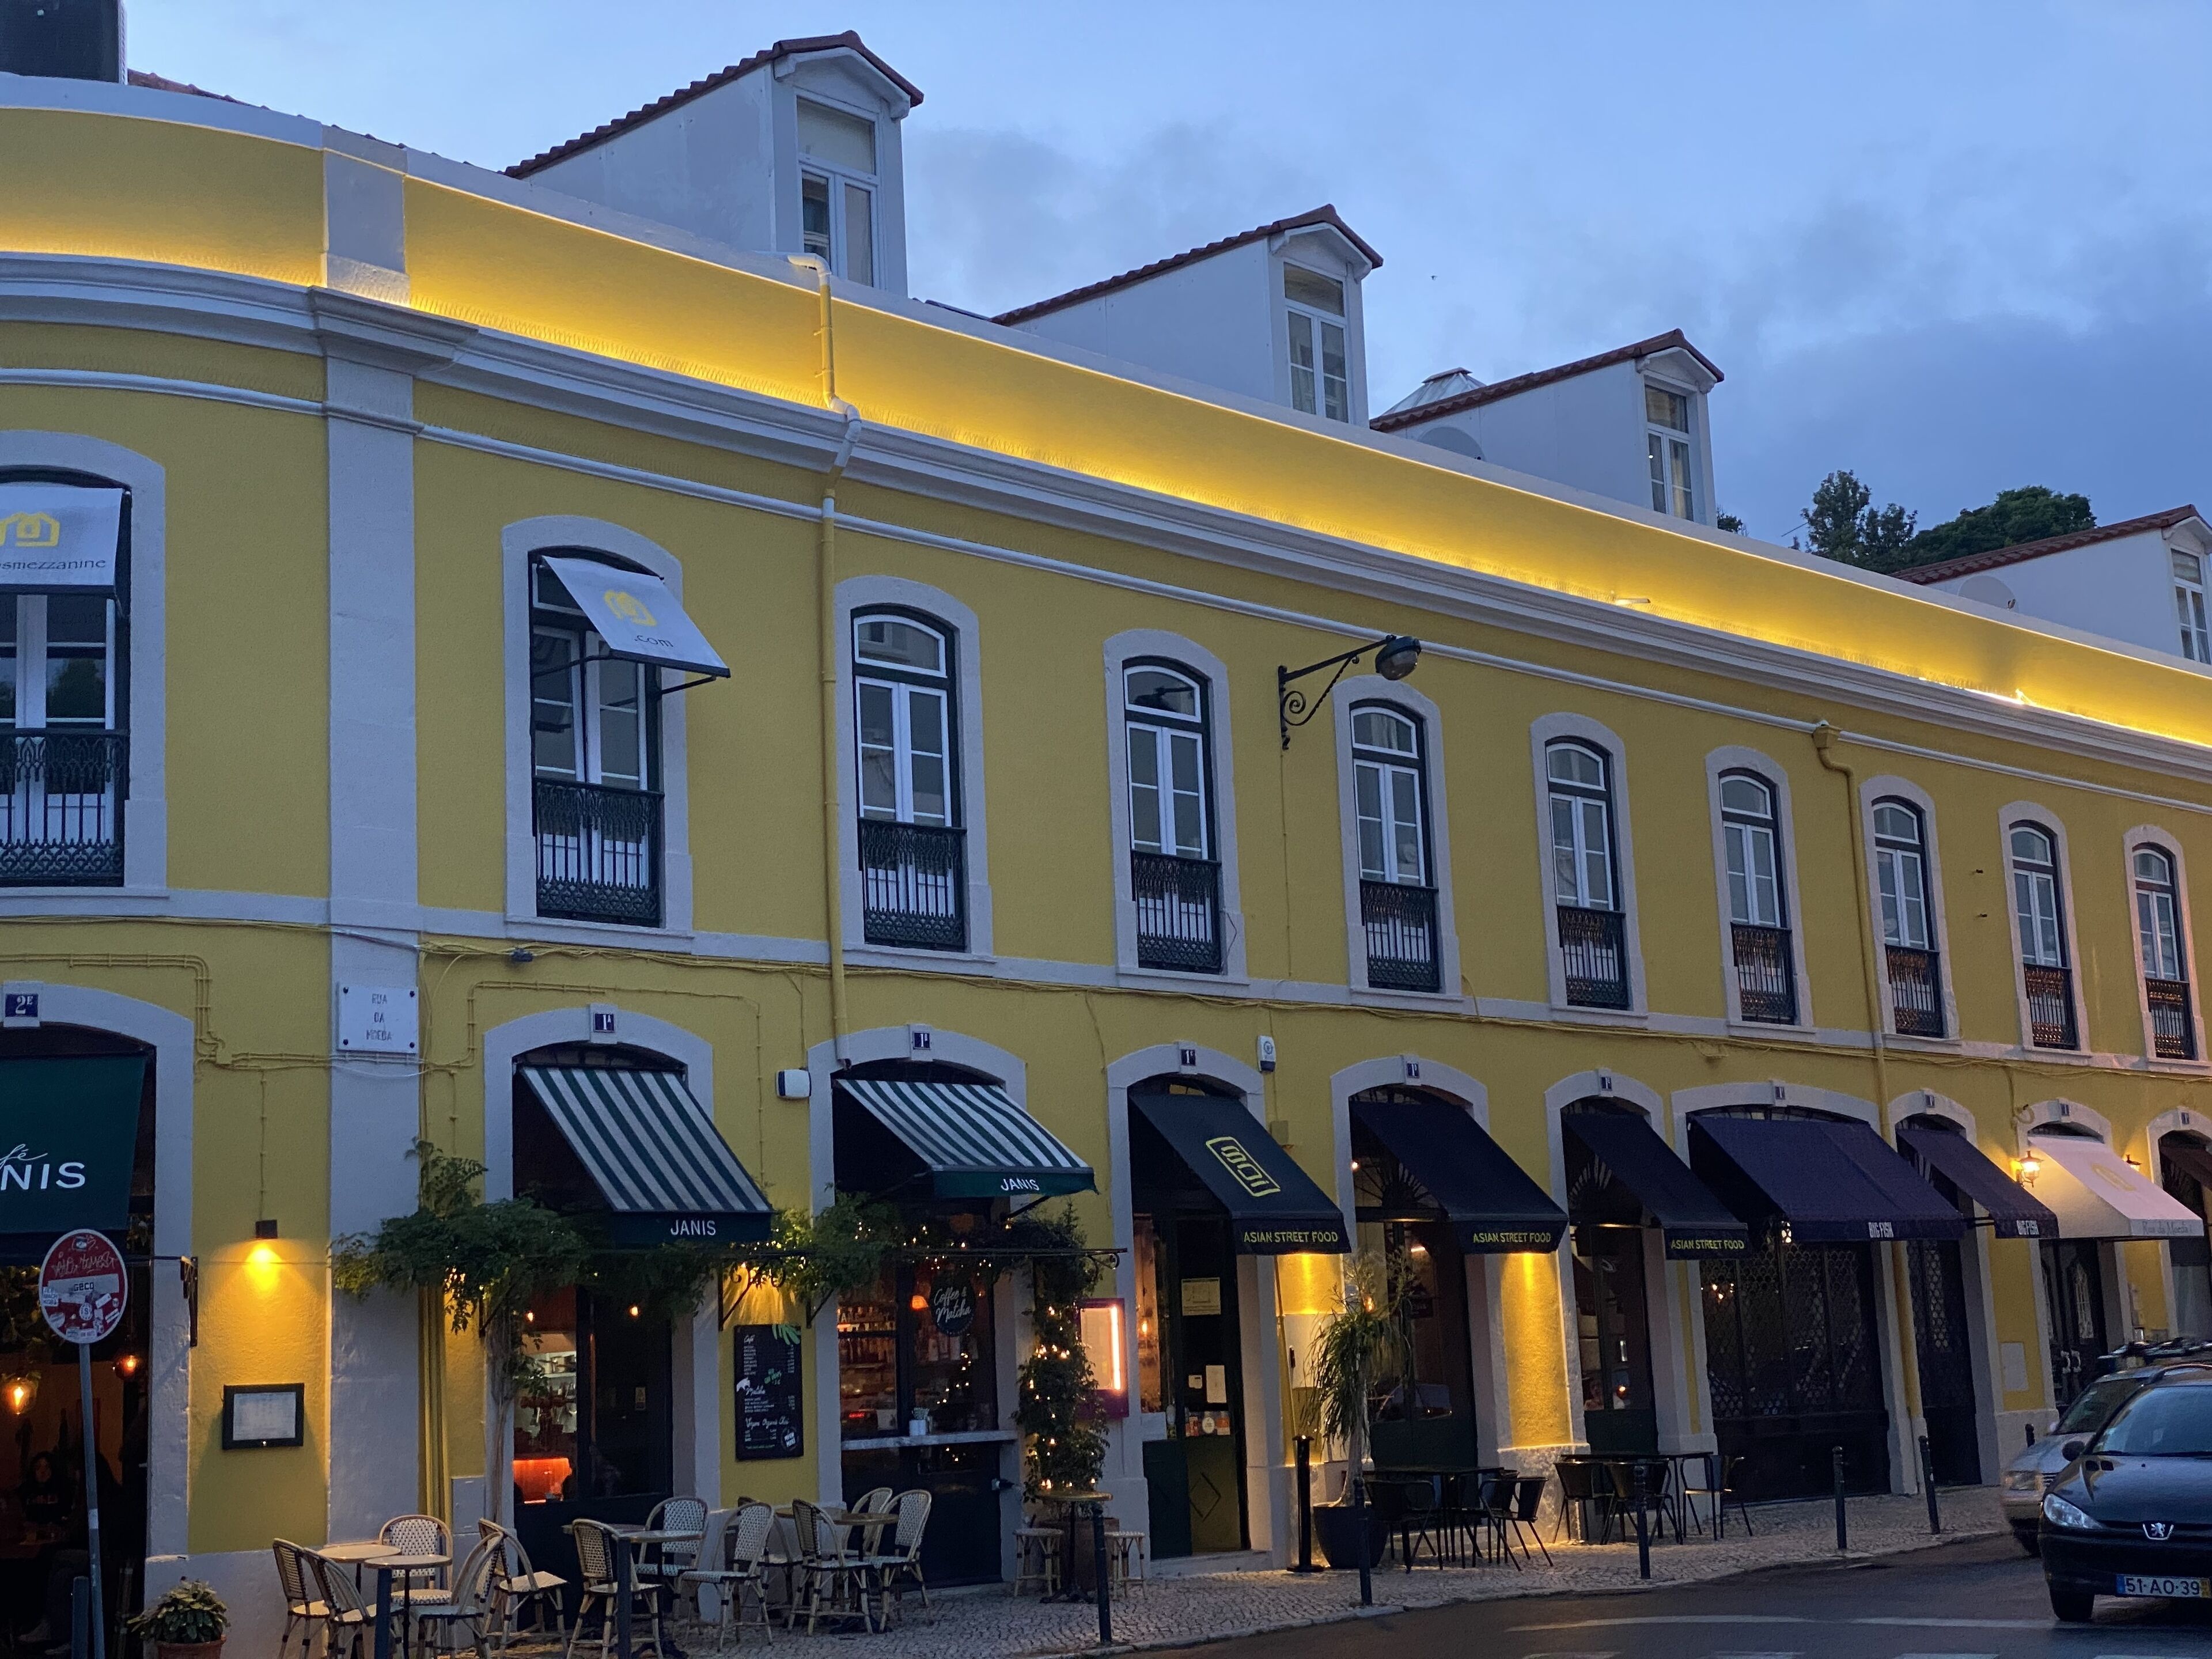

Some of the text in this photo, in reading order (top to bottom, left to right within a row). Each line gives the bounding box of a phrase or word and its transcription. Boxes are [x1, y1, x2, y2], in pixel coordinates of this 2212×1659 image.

[0, 560, 105, 569] smezzanine
[372, 993, 388, 1004] RUA
[374, 1012, 384, 1023] DA
[1, 1162, 85, 1191] NIS
[1001, 1179, 1040, 1191] JANIS
[671, 1219, 716, 1236] JANIS
[1868, 1222, 1894, 1238] BIG FISH
[1244, 1232, 1338, 1243] ASIAN STREET FOOD
[1473, 1232, 1551, 1243] ASIAN STREET FOOD
[1671, 1240, 1745, 1249] ASIAN STREET FOOD
[934, 1287, 959, 1306] Coffee
[935, 1299, 972, 1323] Matcha
